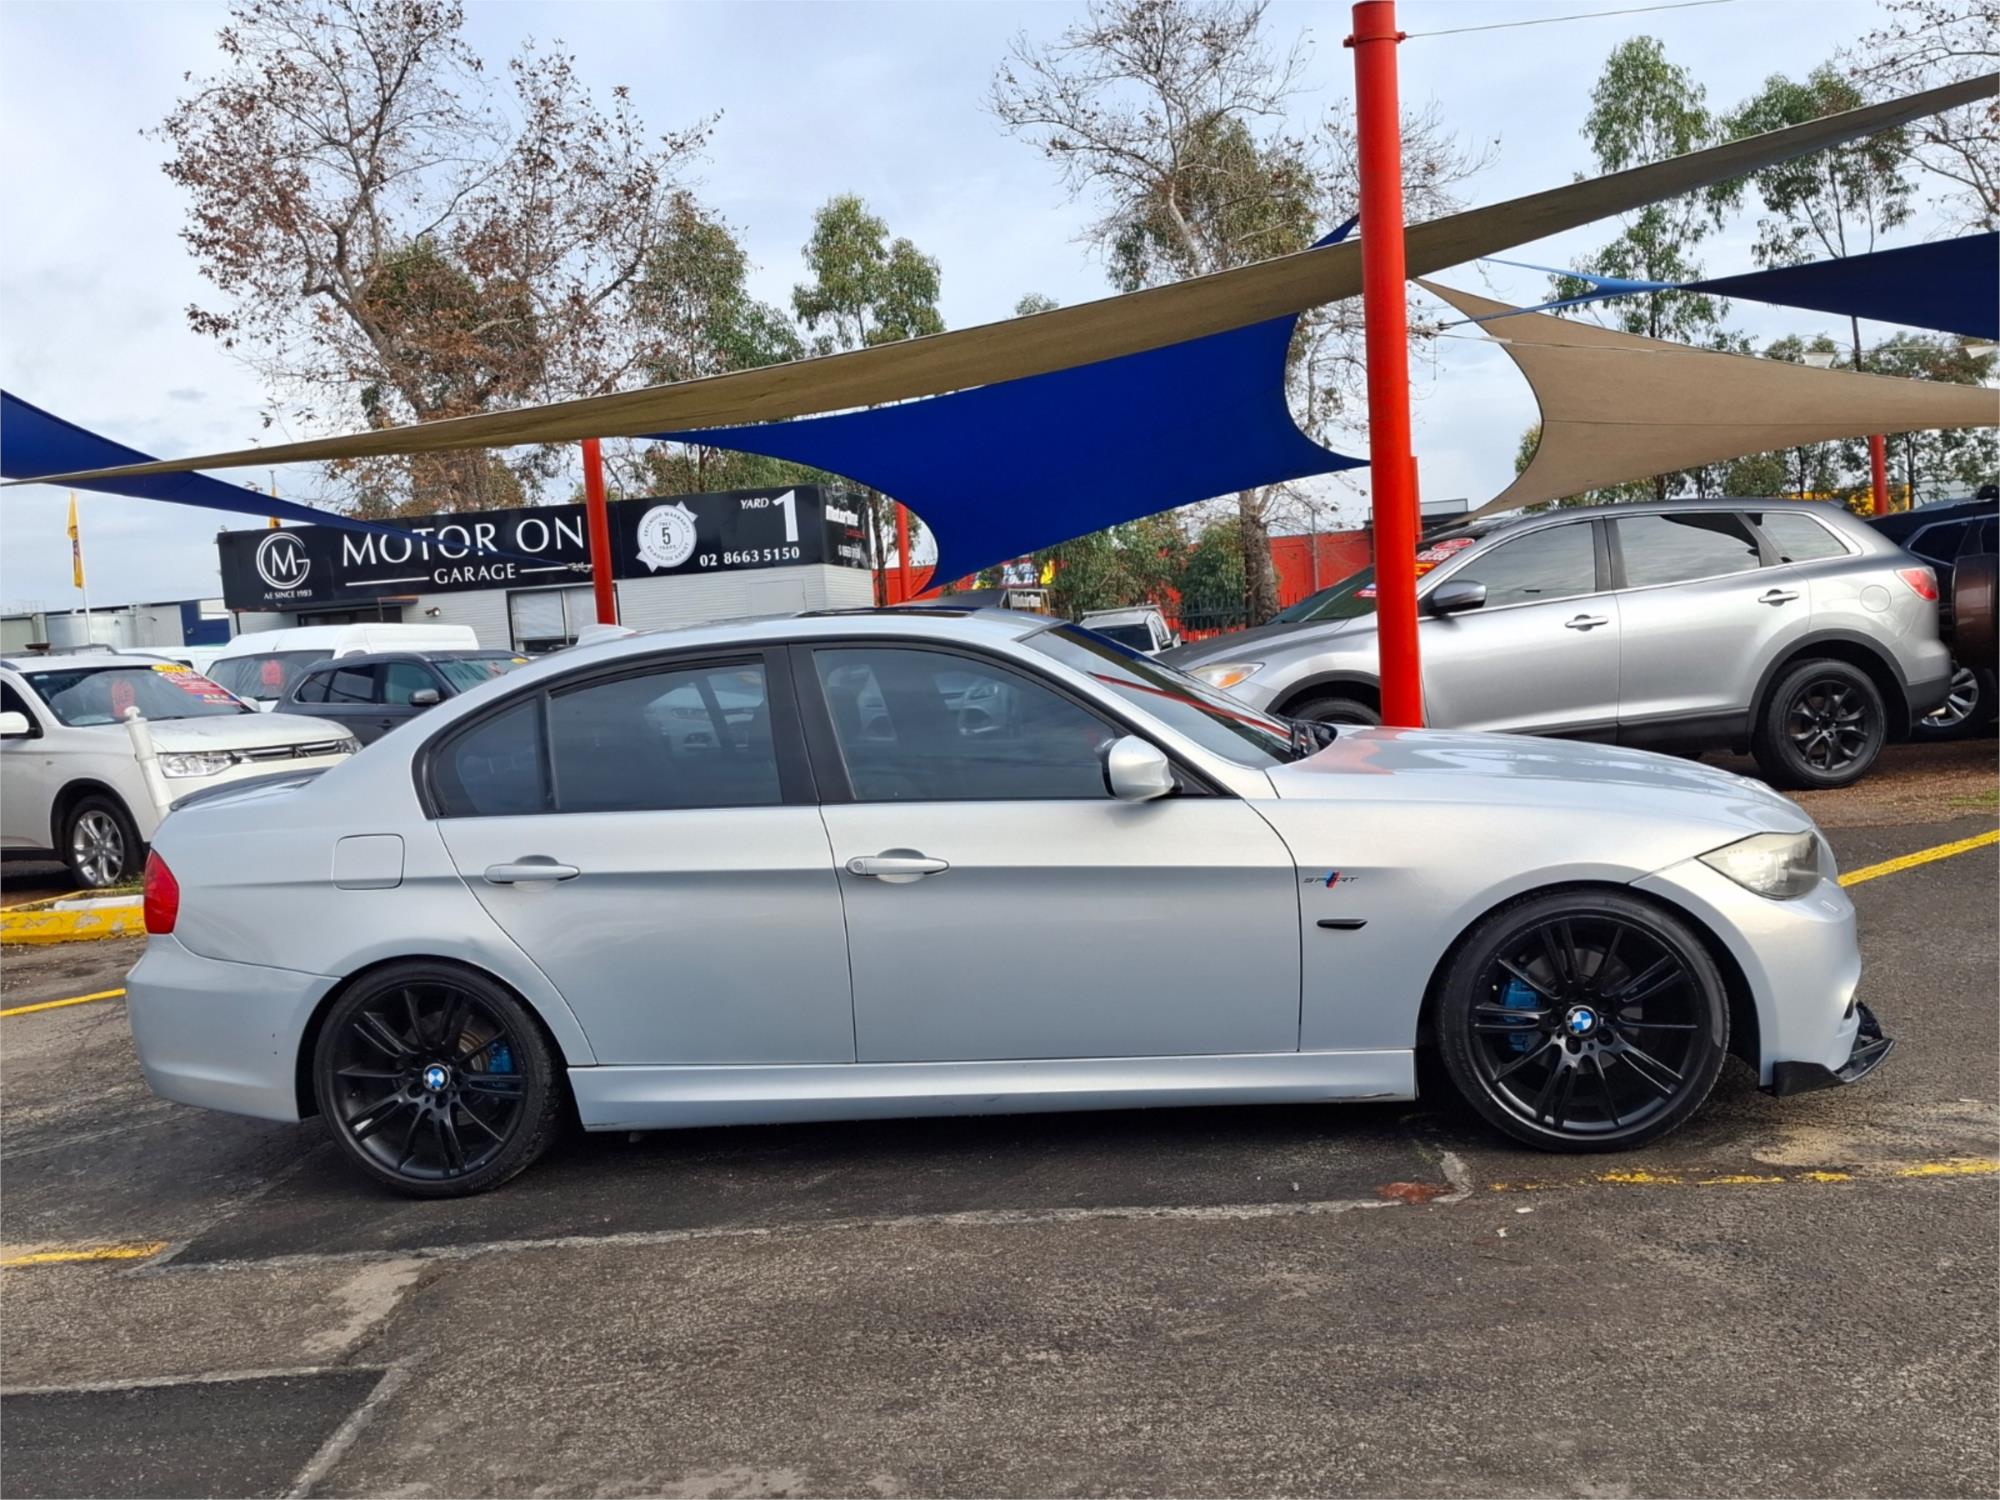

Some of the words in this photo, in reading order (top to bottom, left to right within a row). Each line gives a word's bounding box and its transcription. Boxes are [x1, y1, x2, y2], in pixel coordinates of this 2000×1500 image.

[740, 497, 770, 510] YARD
[772, 489, 799, 542] 1
[343, 523, 499, 567] MOTOR
[516, 515, 584, 553] ON
[661, 526, 672, 546] 5
[699, 553, 718, 567] 02
[723, 549, 760, 565] 8663
[763, 546, 800, 562] 5150
[433, 563, 517, 585] GARAGE
